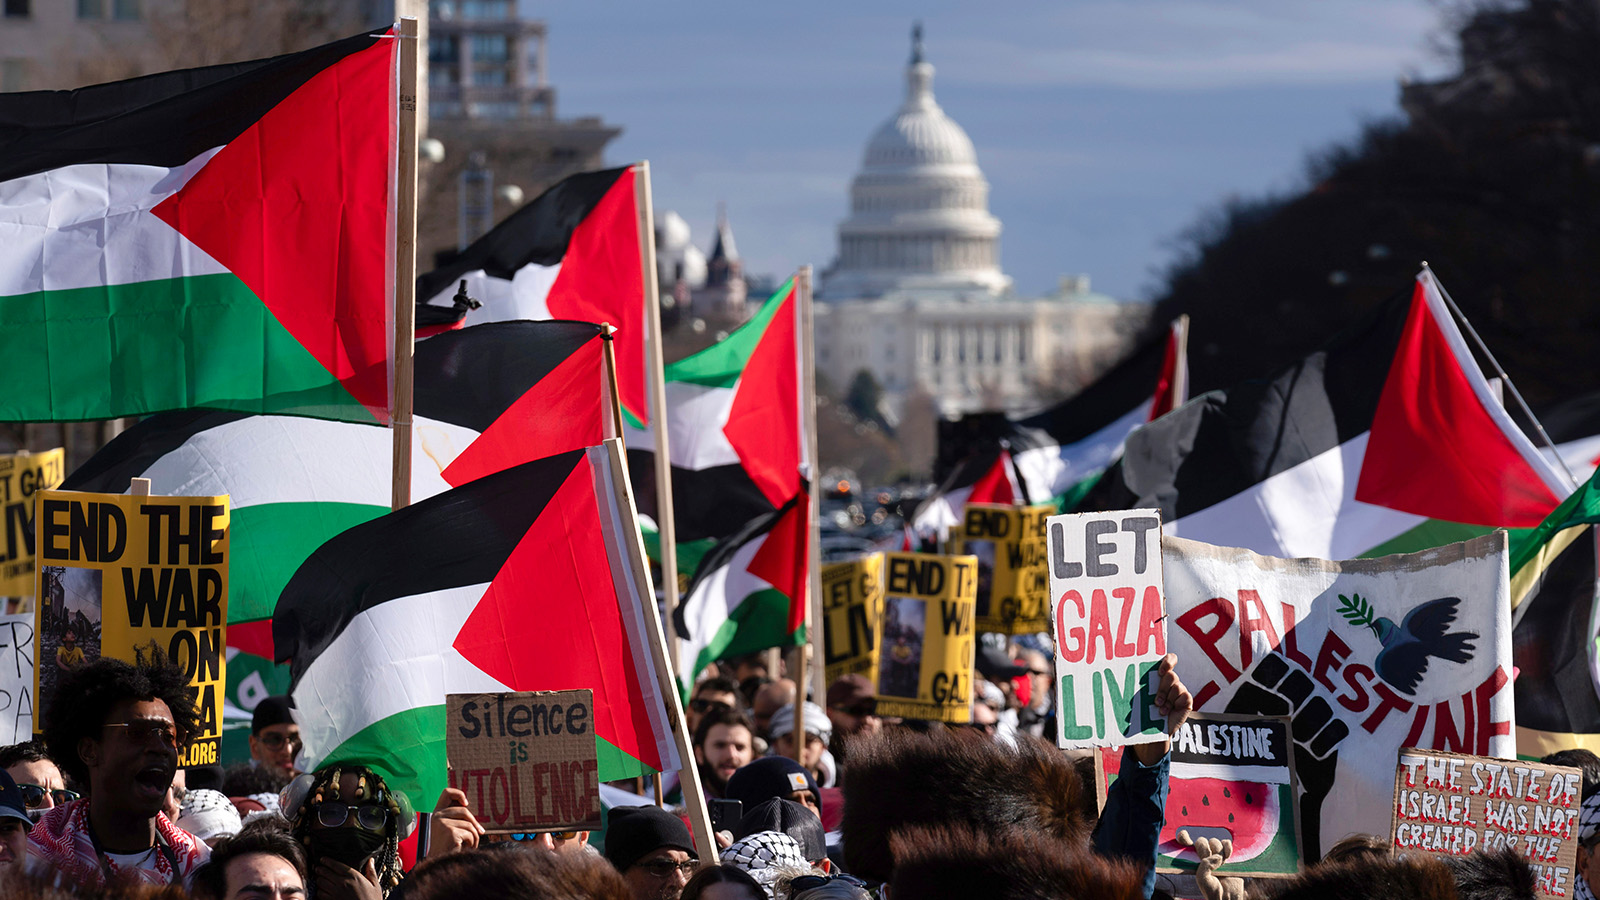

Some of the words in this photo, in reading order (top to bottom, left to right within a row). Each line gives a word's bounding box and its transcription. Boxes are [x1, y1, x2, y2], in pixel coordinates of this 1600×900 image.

[43, 499, 128, 563] END
[140, 504, 225, 566] THE
[967, 509, 1010, 538] END
[1051, 517, 1159, 579] LET
[121, 567, 223, 628] WAR
[888, 557, 945, 596] END
[1057, 585, 1167, 665] GAZA
[168, 628, 220, 683] ON
[1175, 589, 1511, 757] PALESTINE
[1061, 660, 1167, 741] LIVE
[510, 740, 529, 765] is
[1170, 722, 1276, 760] PALESTINE
[449, 759, 600, 826] VIOLENCE
[1400, 755, 1465, 793] THE
[1470, 762, 1546, 804] STATE
[1547, 773, 1581, 808] OF
[1398, 789, 1478, 829] ISRAEL
[1484, 799, 1530, 836] WAS
[1531, 805, 1578, 841] NOT
[1395, 822, 1479, 856] CREATED
[1480, 829, 1520, 856] FOR
[1523, 835, 1562, 864] THE
